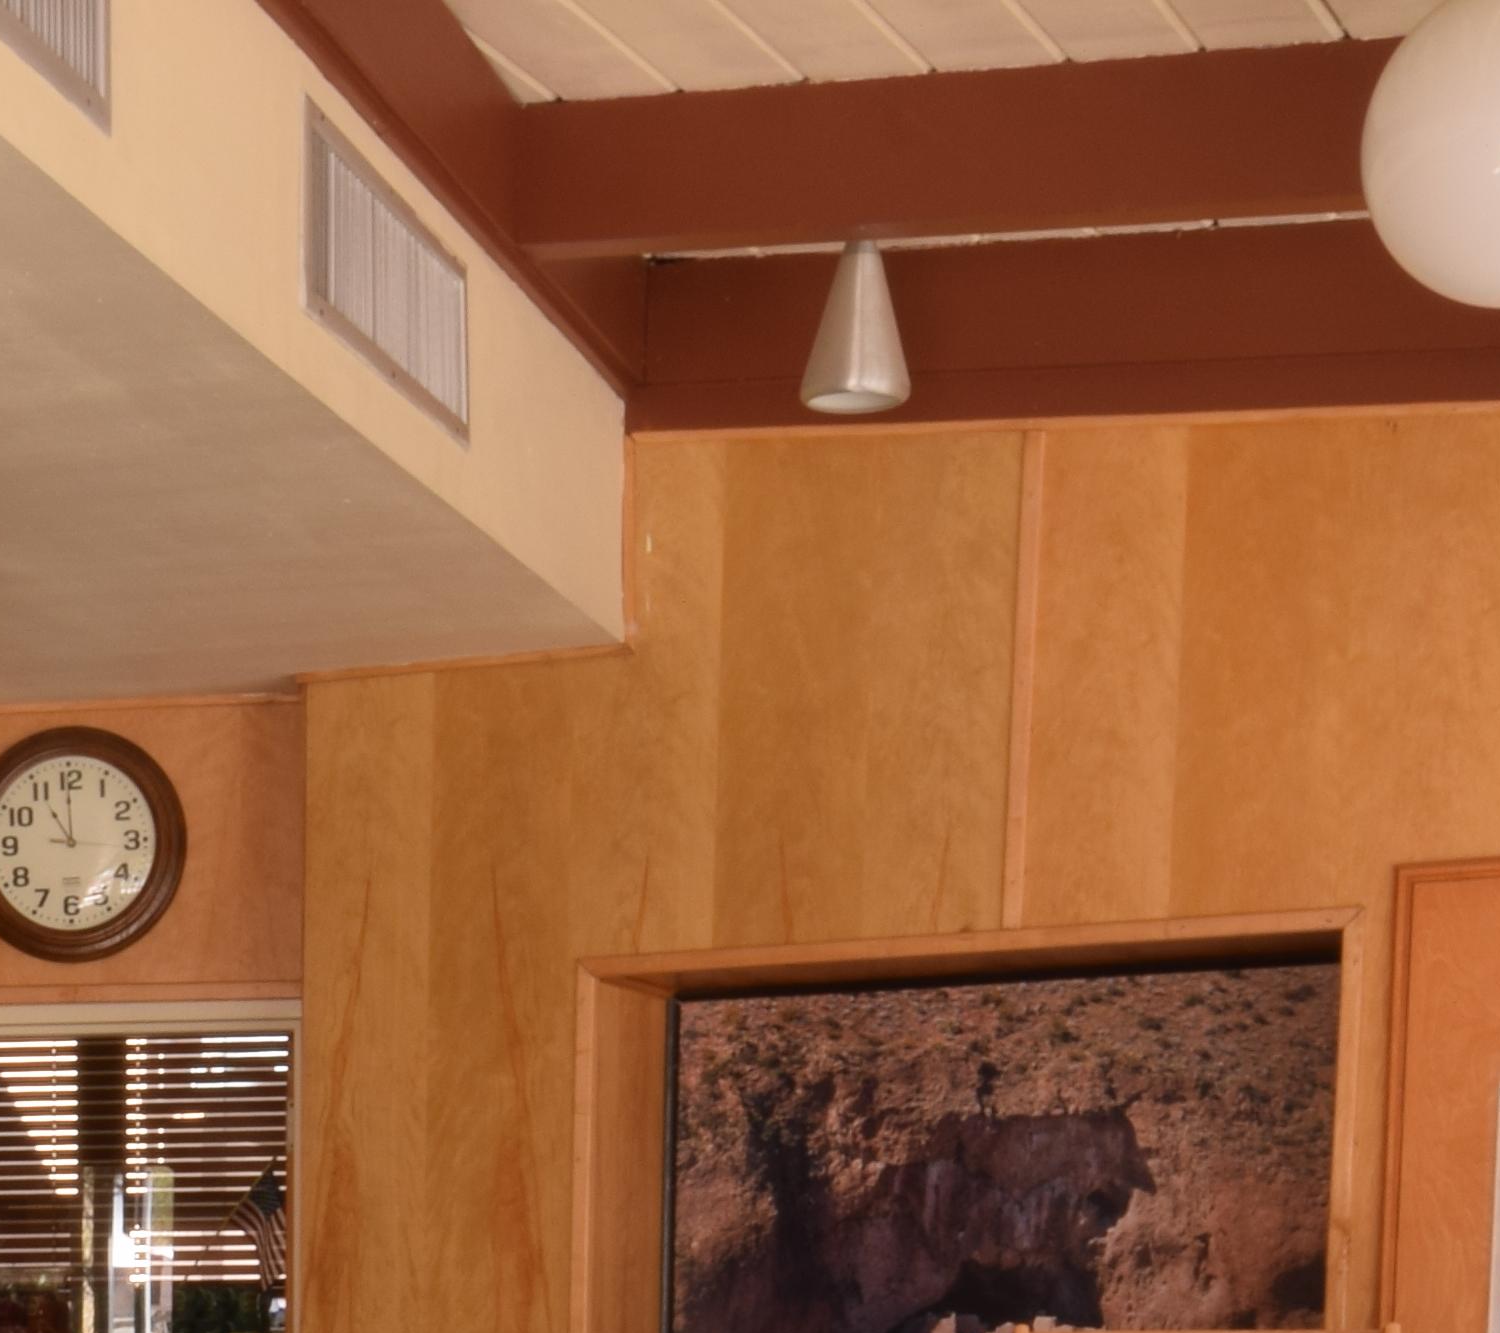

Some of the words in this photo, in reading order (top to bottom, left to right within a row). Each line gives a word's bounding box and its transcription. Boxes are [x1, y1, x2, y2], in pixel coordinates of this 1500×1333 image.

[60, 770, 83, 791] 12
[34, 781, 49, 801] 11
[9, 807, 34, 827] 10
[114, 801, 131, 821] 2
[1, 836, 19, 857] 9
[123, 830, 141, 851] 3
[12, 866, 30, 888] 8
[113, 864, 130, 881] 4
[34, 888, 50, 908] 7
[63, 896, 80, 916] 6
